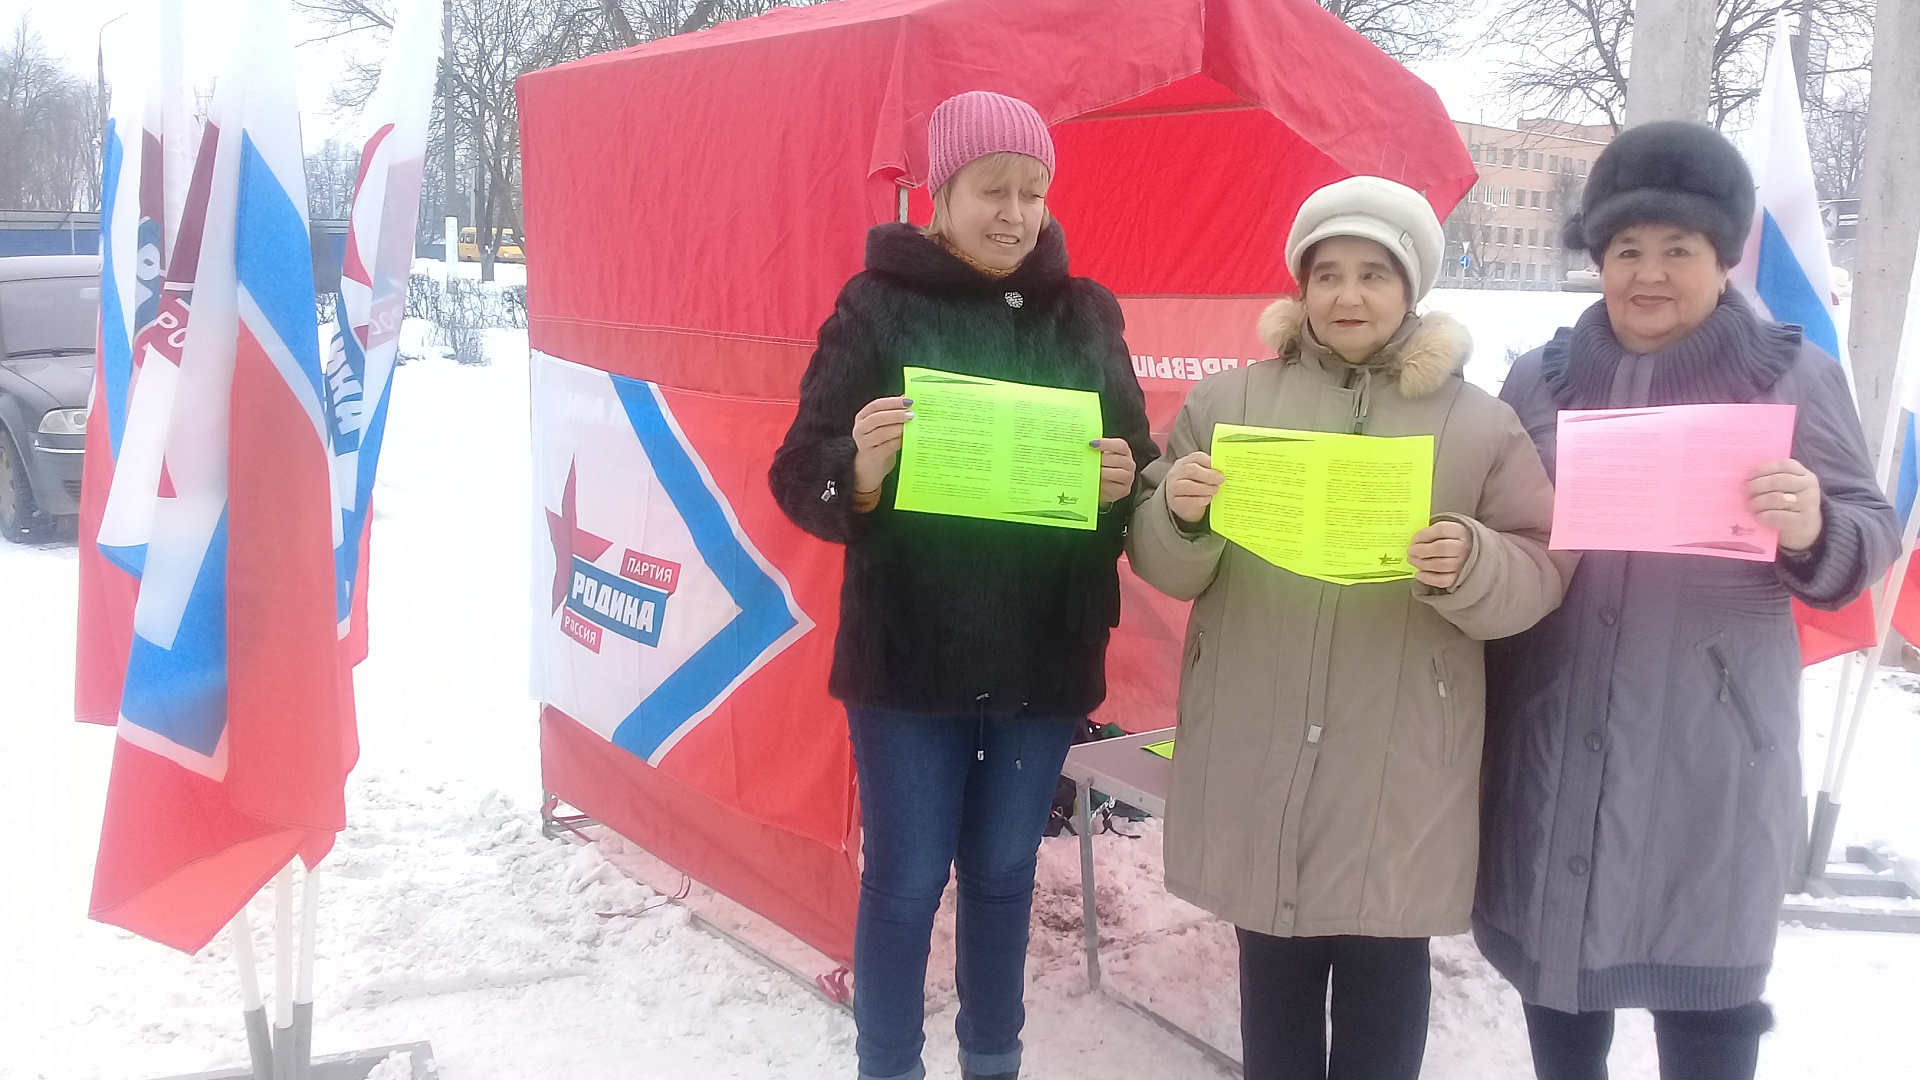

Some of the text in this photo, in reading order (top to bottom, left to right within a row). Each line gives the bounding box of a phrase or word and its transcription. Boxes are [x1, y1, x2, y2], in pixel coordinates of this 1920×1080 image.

[626, 557, 673, 584] ПАРТИЯ
[571, 570, 656, 633] РОДИНА
[564, 615, 598, 646] РОССИЯ
